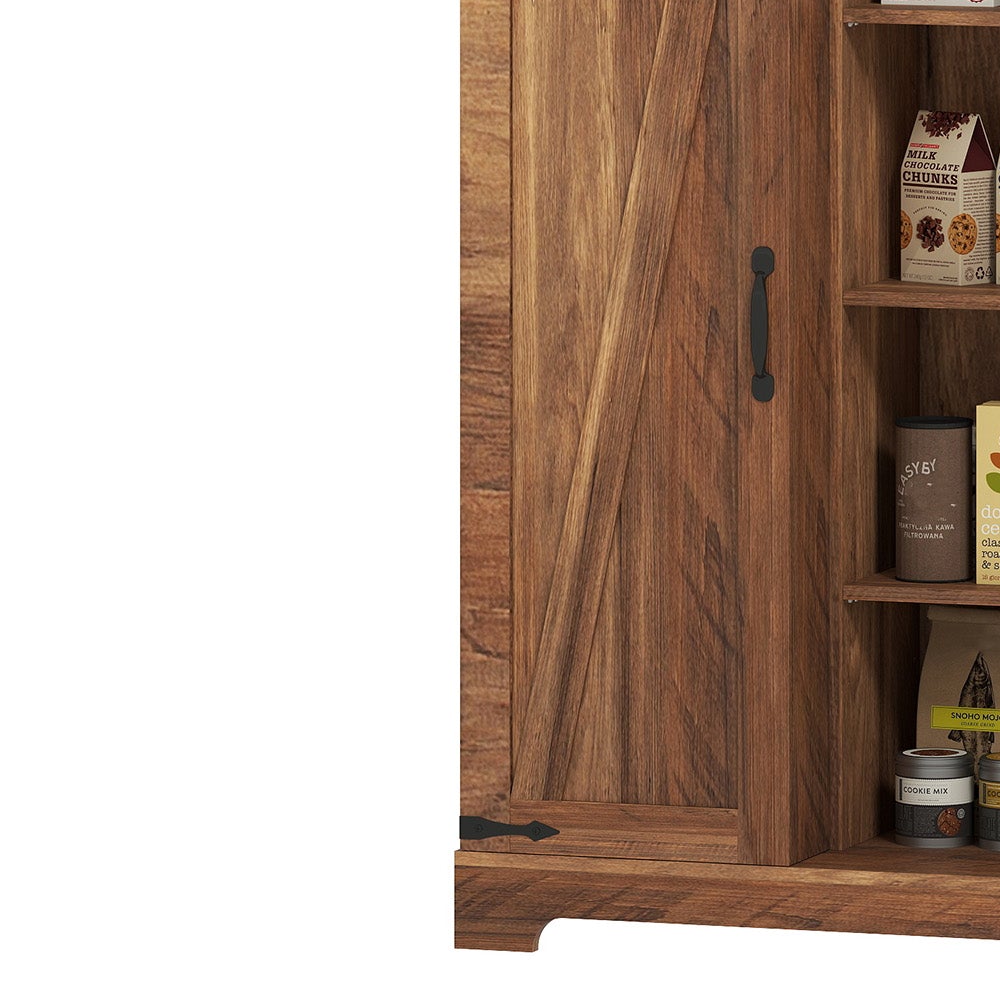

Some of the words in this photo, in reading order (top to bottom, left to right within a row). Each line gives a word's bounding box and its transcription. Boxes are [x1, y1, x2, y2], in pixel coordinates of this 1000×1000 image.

[907, 150, 937, 160] MILK
[904, 161, 960, 172] CHOCOLATE
[903, 171, 958, 185] CHUNKS
[904, 531, 944, 539] FILTROWANA
[981, 560, 991, 569] &
[951, 712, 980, 720] SNOHO
[903, 786, 931, 794] COOKIE
